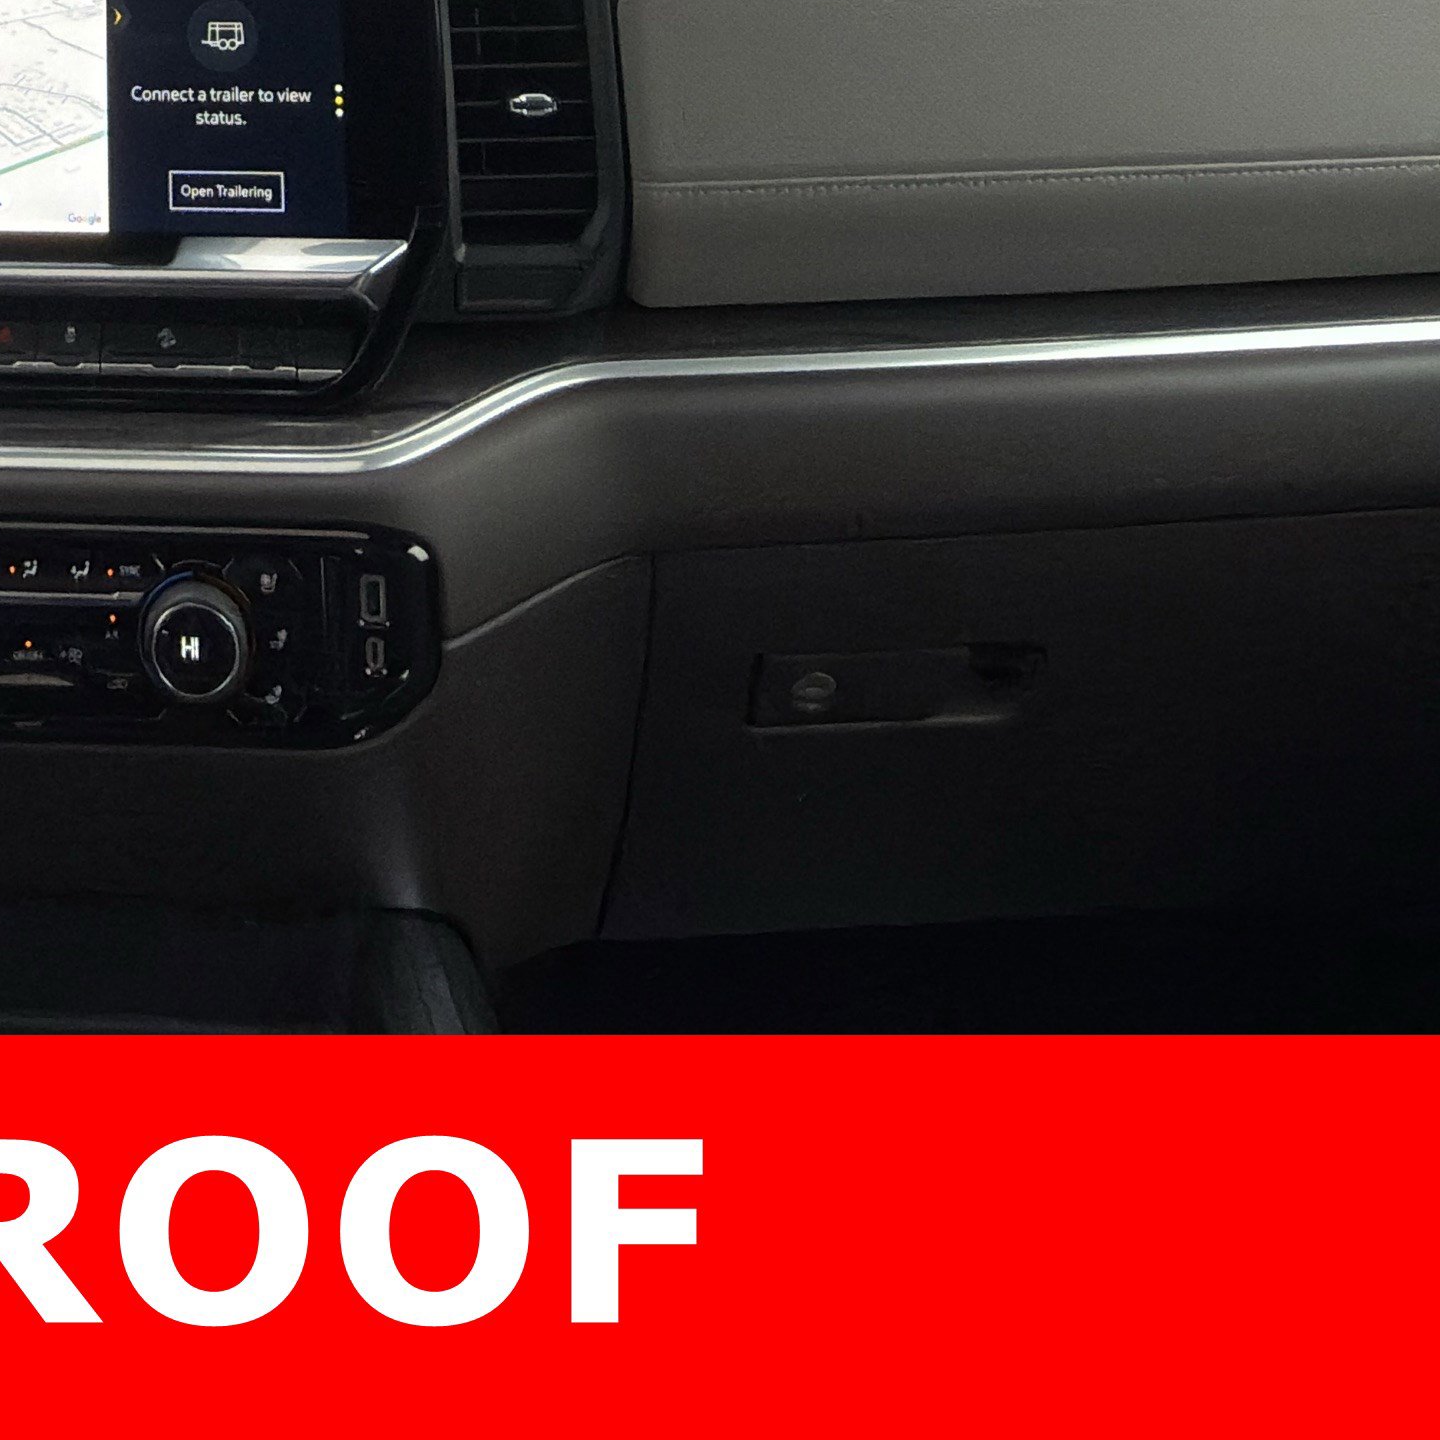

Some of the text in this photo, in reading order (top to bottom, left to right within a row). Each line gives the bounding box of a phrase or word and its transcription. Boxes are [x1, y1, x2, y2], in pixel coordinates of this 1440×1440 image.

[131, 85, 312, 102] Connect a trailer to view
[195, 110, 247, 126] status.
[180, 184, 273, 201] Open Trailering
[67, 212, 102, 225] Google
[180, 635, 200, 662] HI
